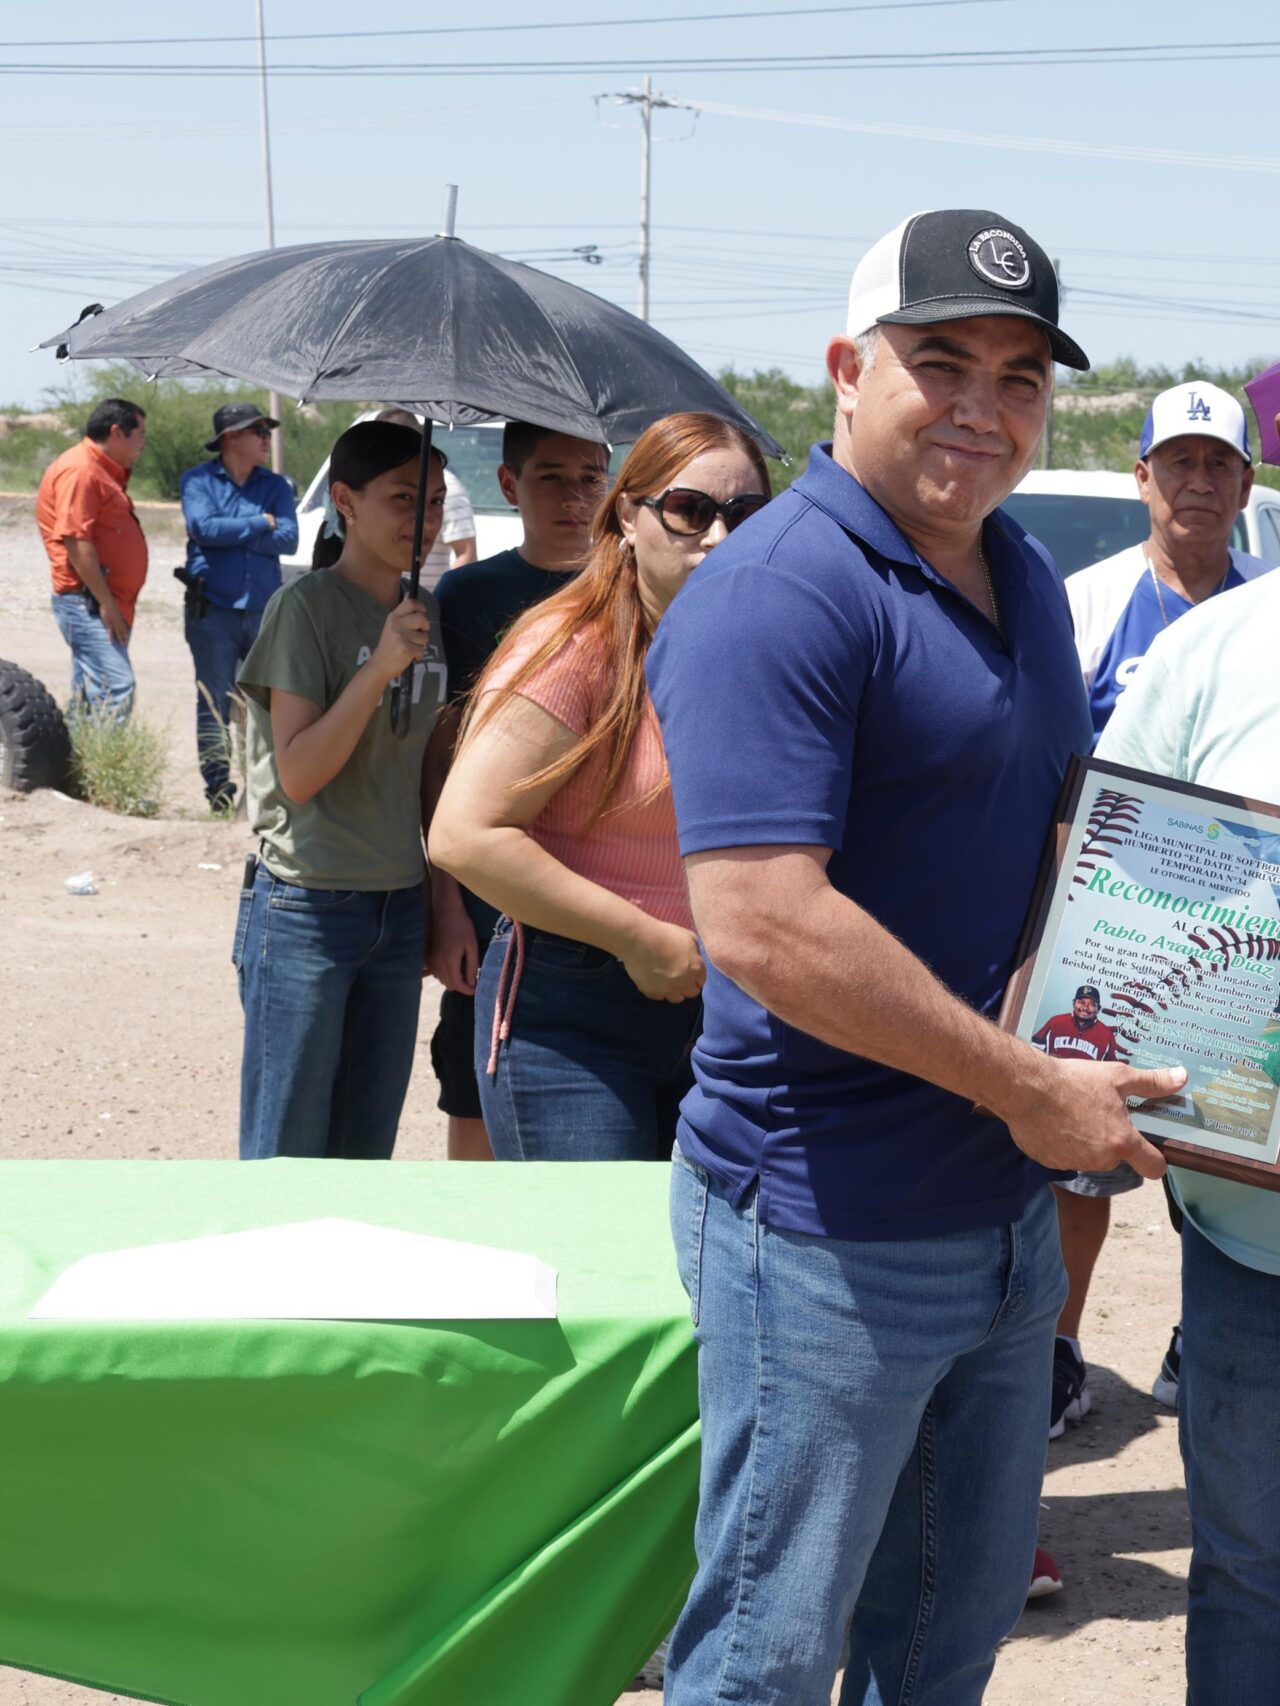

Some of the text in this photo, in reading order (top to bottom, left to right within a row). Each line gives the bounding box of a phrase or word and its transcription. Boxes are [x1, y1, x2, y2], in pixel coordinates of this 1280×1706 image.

[969, 241, 981, 252] LA
[1187, 392, 1212, 422] LA
[1168, 818, 1204, 834] SABINAS
[1124, 838, 1182, 858] HUMBERTO
[1134, 830, 1158, 842] LIGA
[1161, 836, 1217, 858] MUNICIPAL
[1220, 852, 1234, 862] DE
[1150, 867, 1250, 898] LE OTORGA EL MERECIDO
[1160, 858, 1223, 880] TEMPORADA
[1172, 920, 1206, 937] AL C.
[1085, 938, 1274, 992] Por su gran trayectoria como jugador de
[1093, 920, 1275, 980] Pablo Aranda Díaz
[1062, 957, 1096, 972] Beisbol
[1098, 967, 1129, 981] dentro
[1142, 978, 1164, 990] fuera
[1168, 984, 1180, 994] de
[1074, 949, 1092, 959] esta
[1097, 952, 1112, 964] liga
[1116, 958, 1127, 968] de
[1186, 978, 1210, 990] como
[1255, 996, 1266, 1004] en
[1269, 998, 1278, 1007] el
[1087, 976, 1253, 1026] del Municipio de Sabinas, Coahuila.
[1112, 1002, 1160, 1020] Patrocinado
[1164, 1018, 1178, 1027] por
[1191, 1022, 1234, 1039] Presidente
[1237, 1034, 1278, 1051] Municipal
[1128, 1029, 1152, 1042] Mesa
[1156, 1035, 1200, 1054] Directiva
[1204, 1048, 1216, 1058] de
[1220, 1052, 1238, 1064] Esta
[1242, 1057, 1262, 1070] Liga
